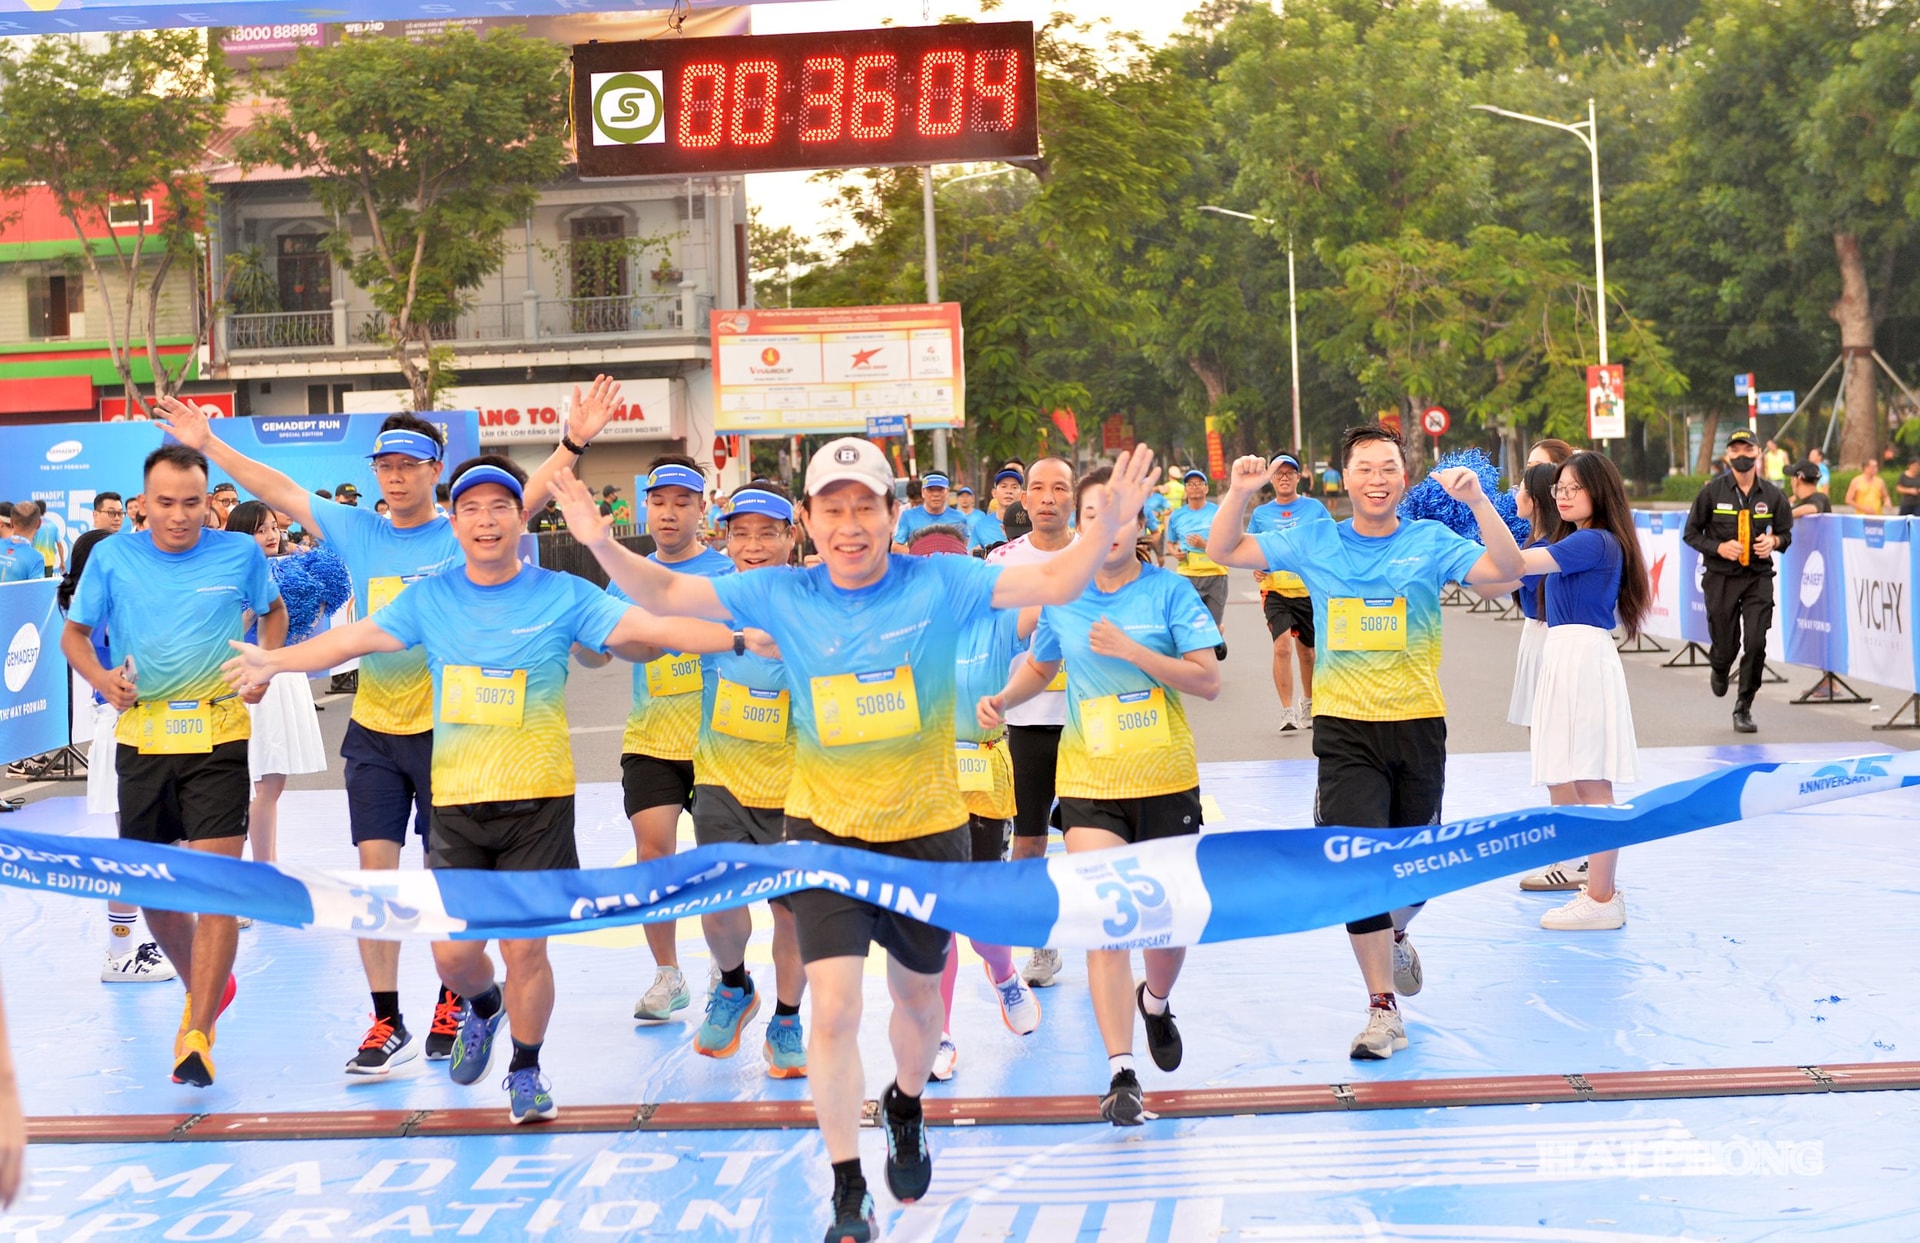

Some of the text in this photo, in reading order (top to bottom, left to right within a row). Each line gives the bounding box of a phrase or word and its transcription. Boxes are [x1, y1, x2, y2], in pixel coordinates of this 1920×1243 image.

[262, 419, 341, 432] GEMADEPT RUN
[31, 490, 65, 501] GEMADEPT
[1360, 616, 1398, 632] 50878
[6, 647, 39, 668] GEMADEPT
[474, 686, 516, 706] 50873
[855, 690, 906, 717] 50886
[10, 706, 22, 719] WAY
[22, 699, 48, 716] FORWARD
[742, 705, 781, 723] 50875
[165, 718, 203, 735] 50870
[1117, 709, 1158, 732] 50869
[1392, 824, 1557, 879] SPECIAL EDITION
[46, 872, 122, 897] EDITION
